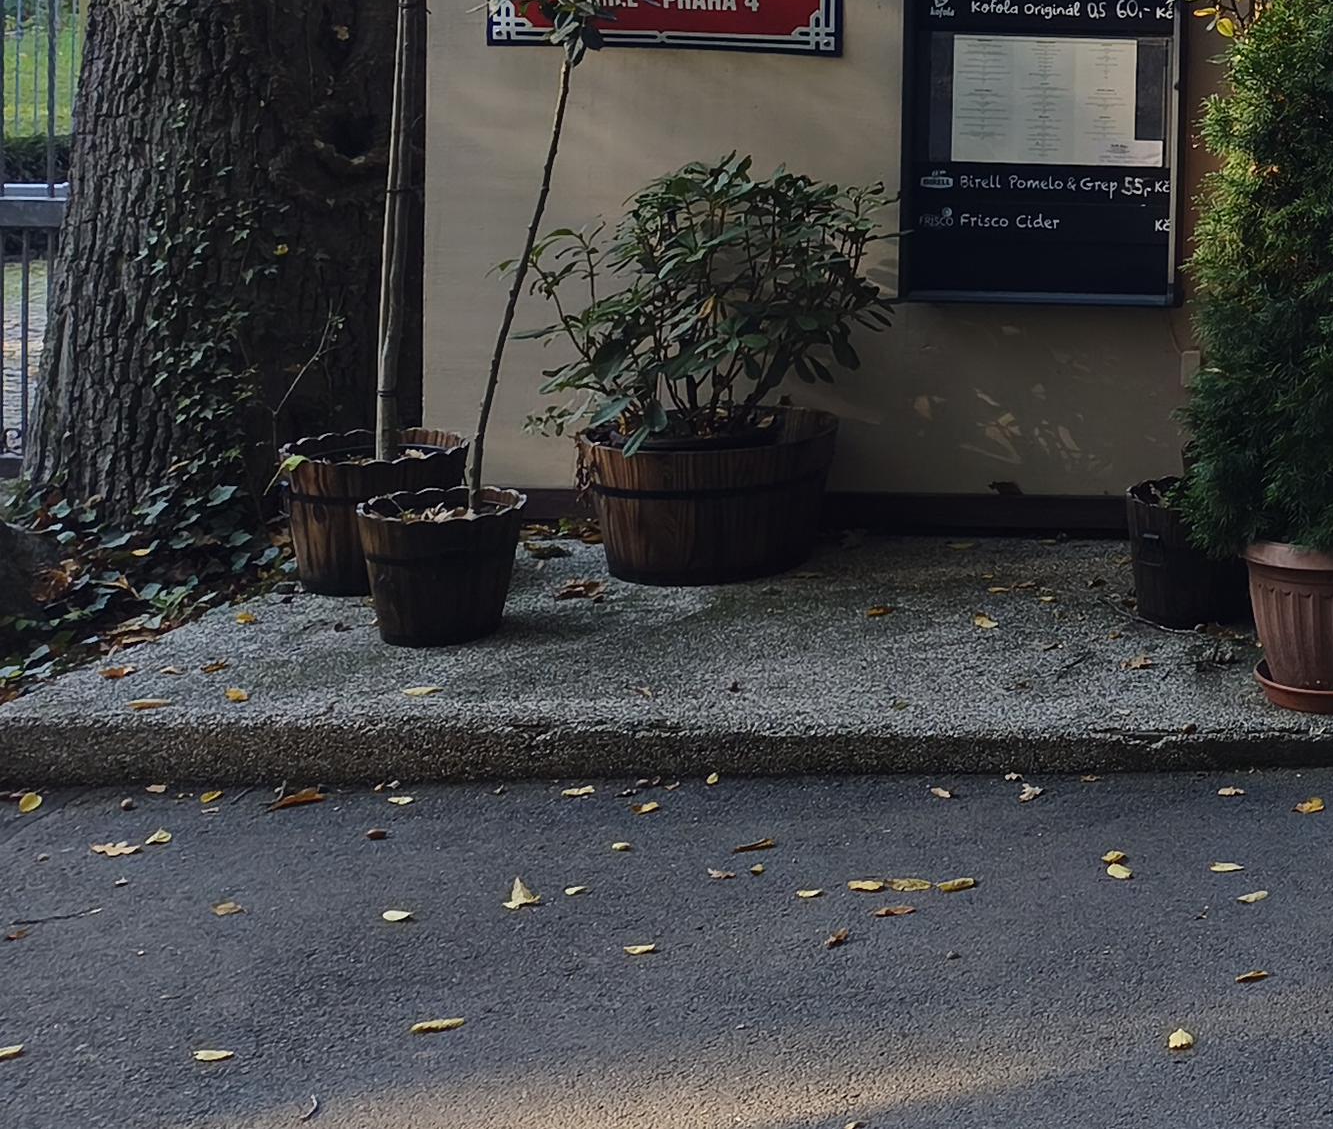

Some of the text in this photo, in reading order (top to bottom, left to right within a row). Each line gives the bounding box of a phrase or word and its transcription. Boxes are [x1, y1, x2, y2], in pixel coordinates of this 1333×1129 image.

[970, 0, 1019, 15] Kofola
[1023, 0, 1081, 20] Originál
[960, 174, 1002, 190] Birell
[1008, 174, 1064, 190] Pomelo
[1080, 176, 1118, 199] Grep
[960, 213, 1010, 229] Frisco
[1015, 214, 1061, 230] Cider
